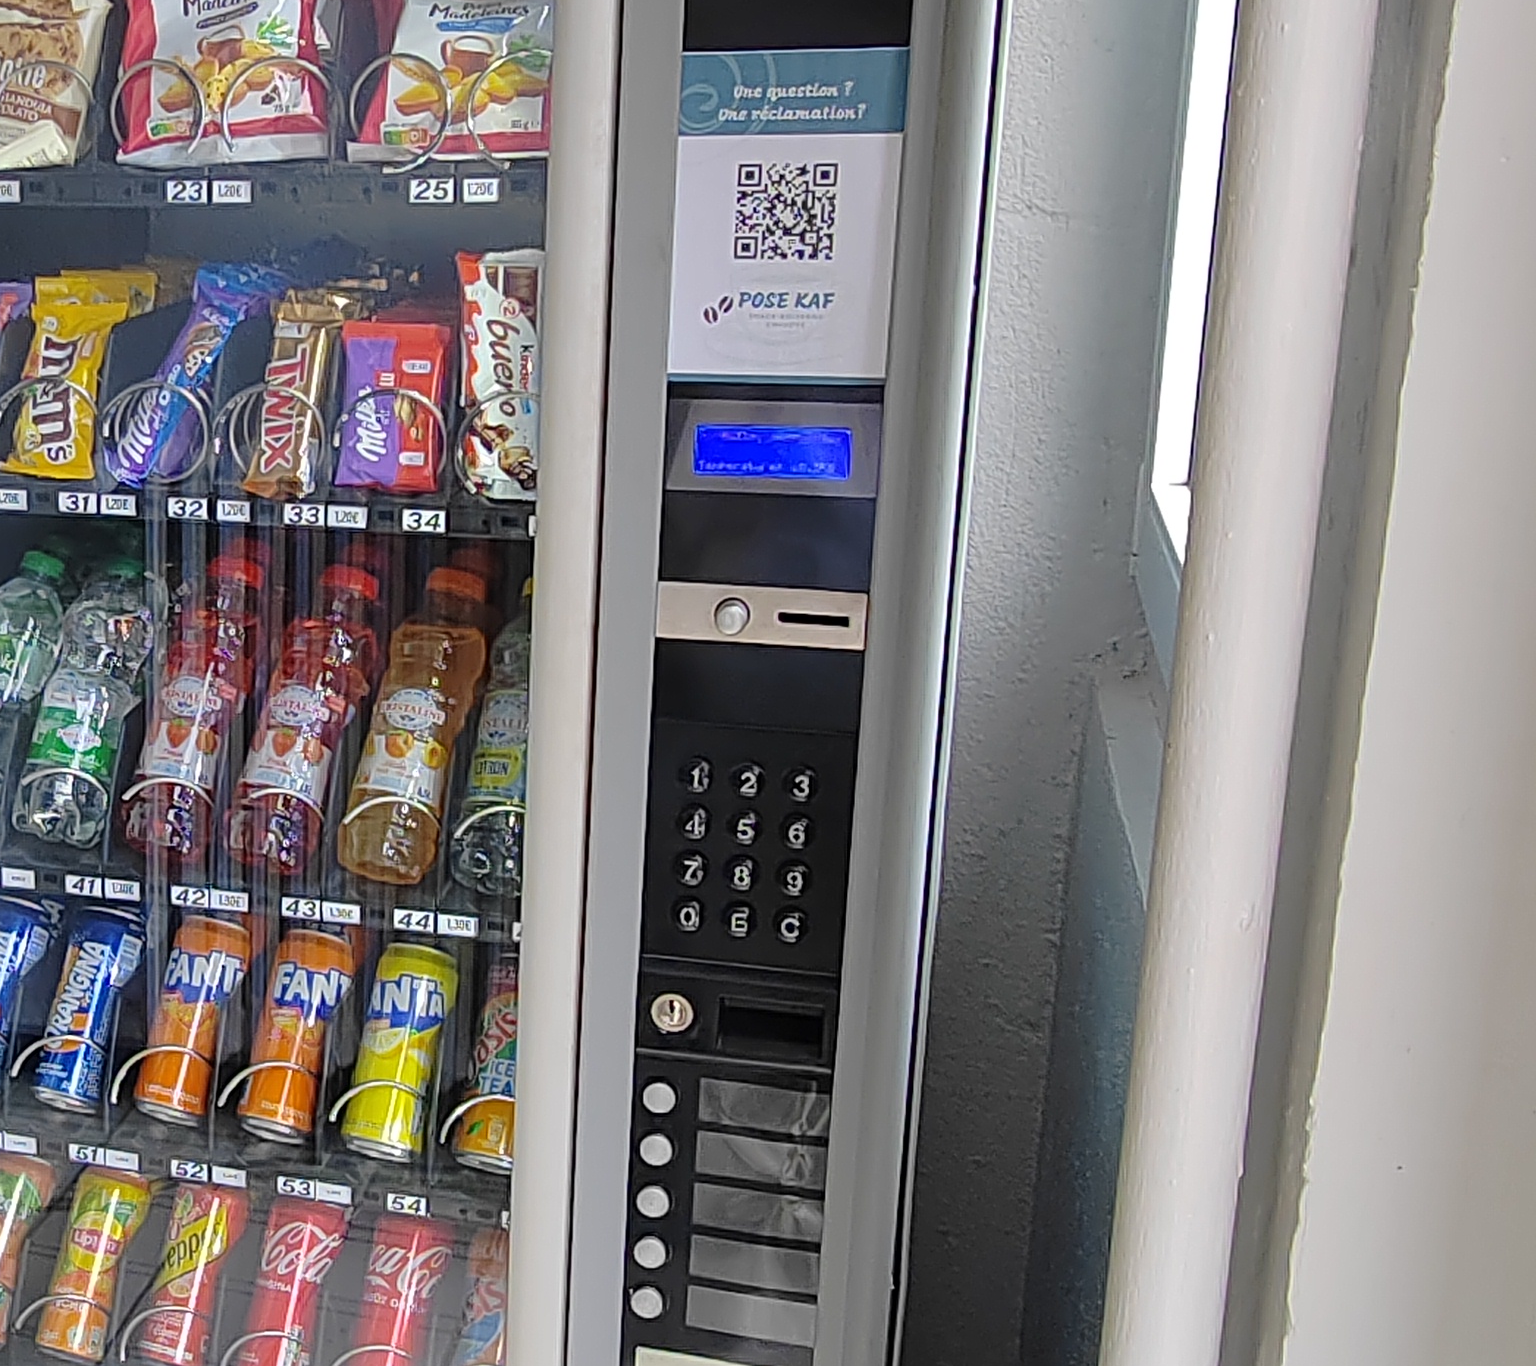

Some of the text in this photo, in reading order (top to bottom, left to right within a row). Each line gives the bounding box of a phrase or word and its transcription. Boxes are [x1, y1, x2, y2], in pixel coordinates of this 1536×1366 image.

[734, 85, 762, 98] Une
[766, 84, 838, 101] question
[718, 108, 748, 122] Une
[171, 182, 203, 201] 23
[413, 181, 449, 201] 25
[738, 292, 835, 309] POSE KAF
[261, 343, 310, 473] TWIX
[66, 495, 89, 513] 31
[171, 499, 203, 517] 32
[288, 506, 320, 524] 33
[406, 512, 442, 531] 34
[690, 767, 809, 797] 1 2 3
[685, 814, 805, 845] 4 5 6
[683, 860, 803, 892] 7 8 9
[71, 877, 96, 895] 41
[174, 888, 206, 907] 42
[286, 899, 317, 918] 43
[397, 912, 431, 931] 44
[730, 912, 748, 933] E
[780, 917, 800, 938] C
[47, 940, 111, 1050] ORANGINA
[480, 1075, 514, 1096] TEA
[75, 1145, 97, 1162] 51
[175, 1162, 204, 1177] 52
[282, 1178, 311, 1195] 53
[390, 1195, 423, 1213] 54
